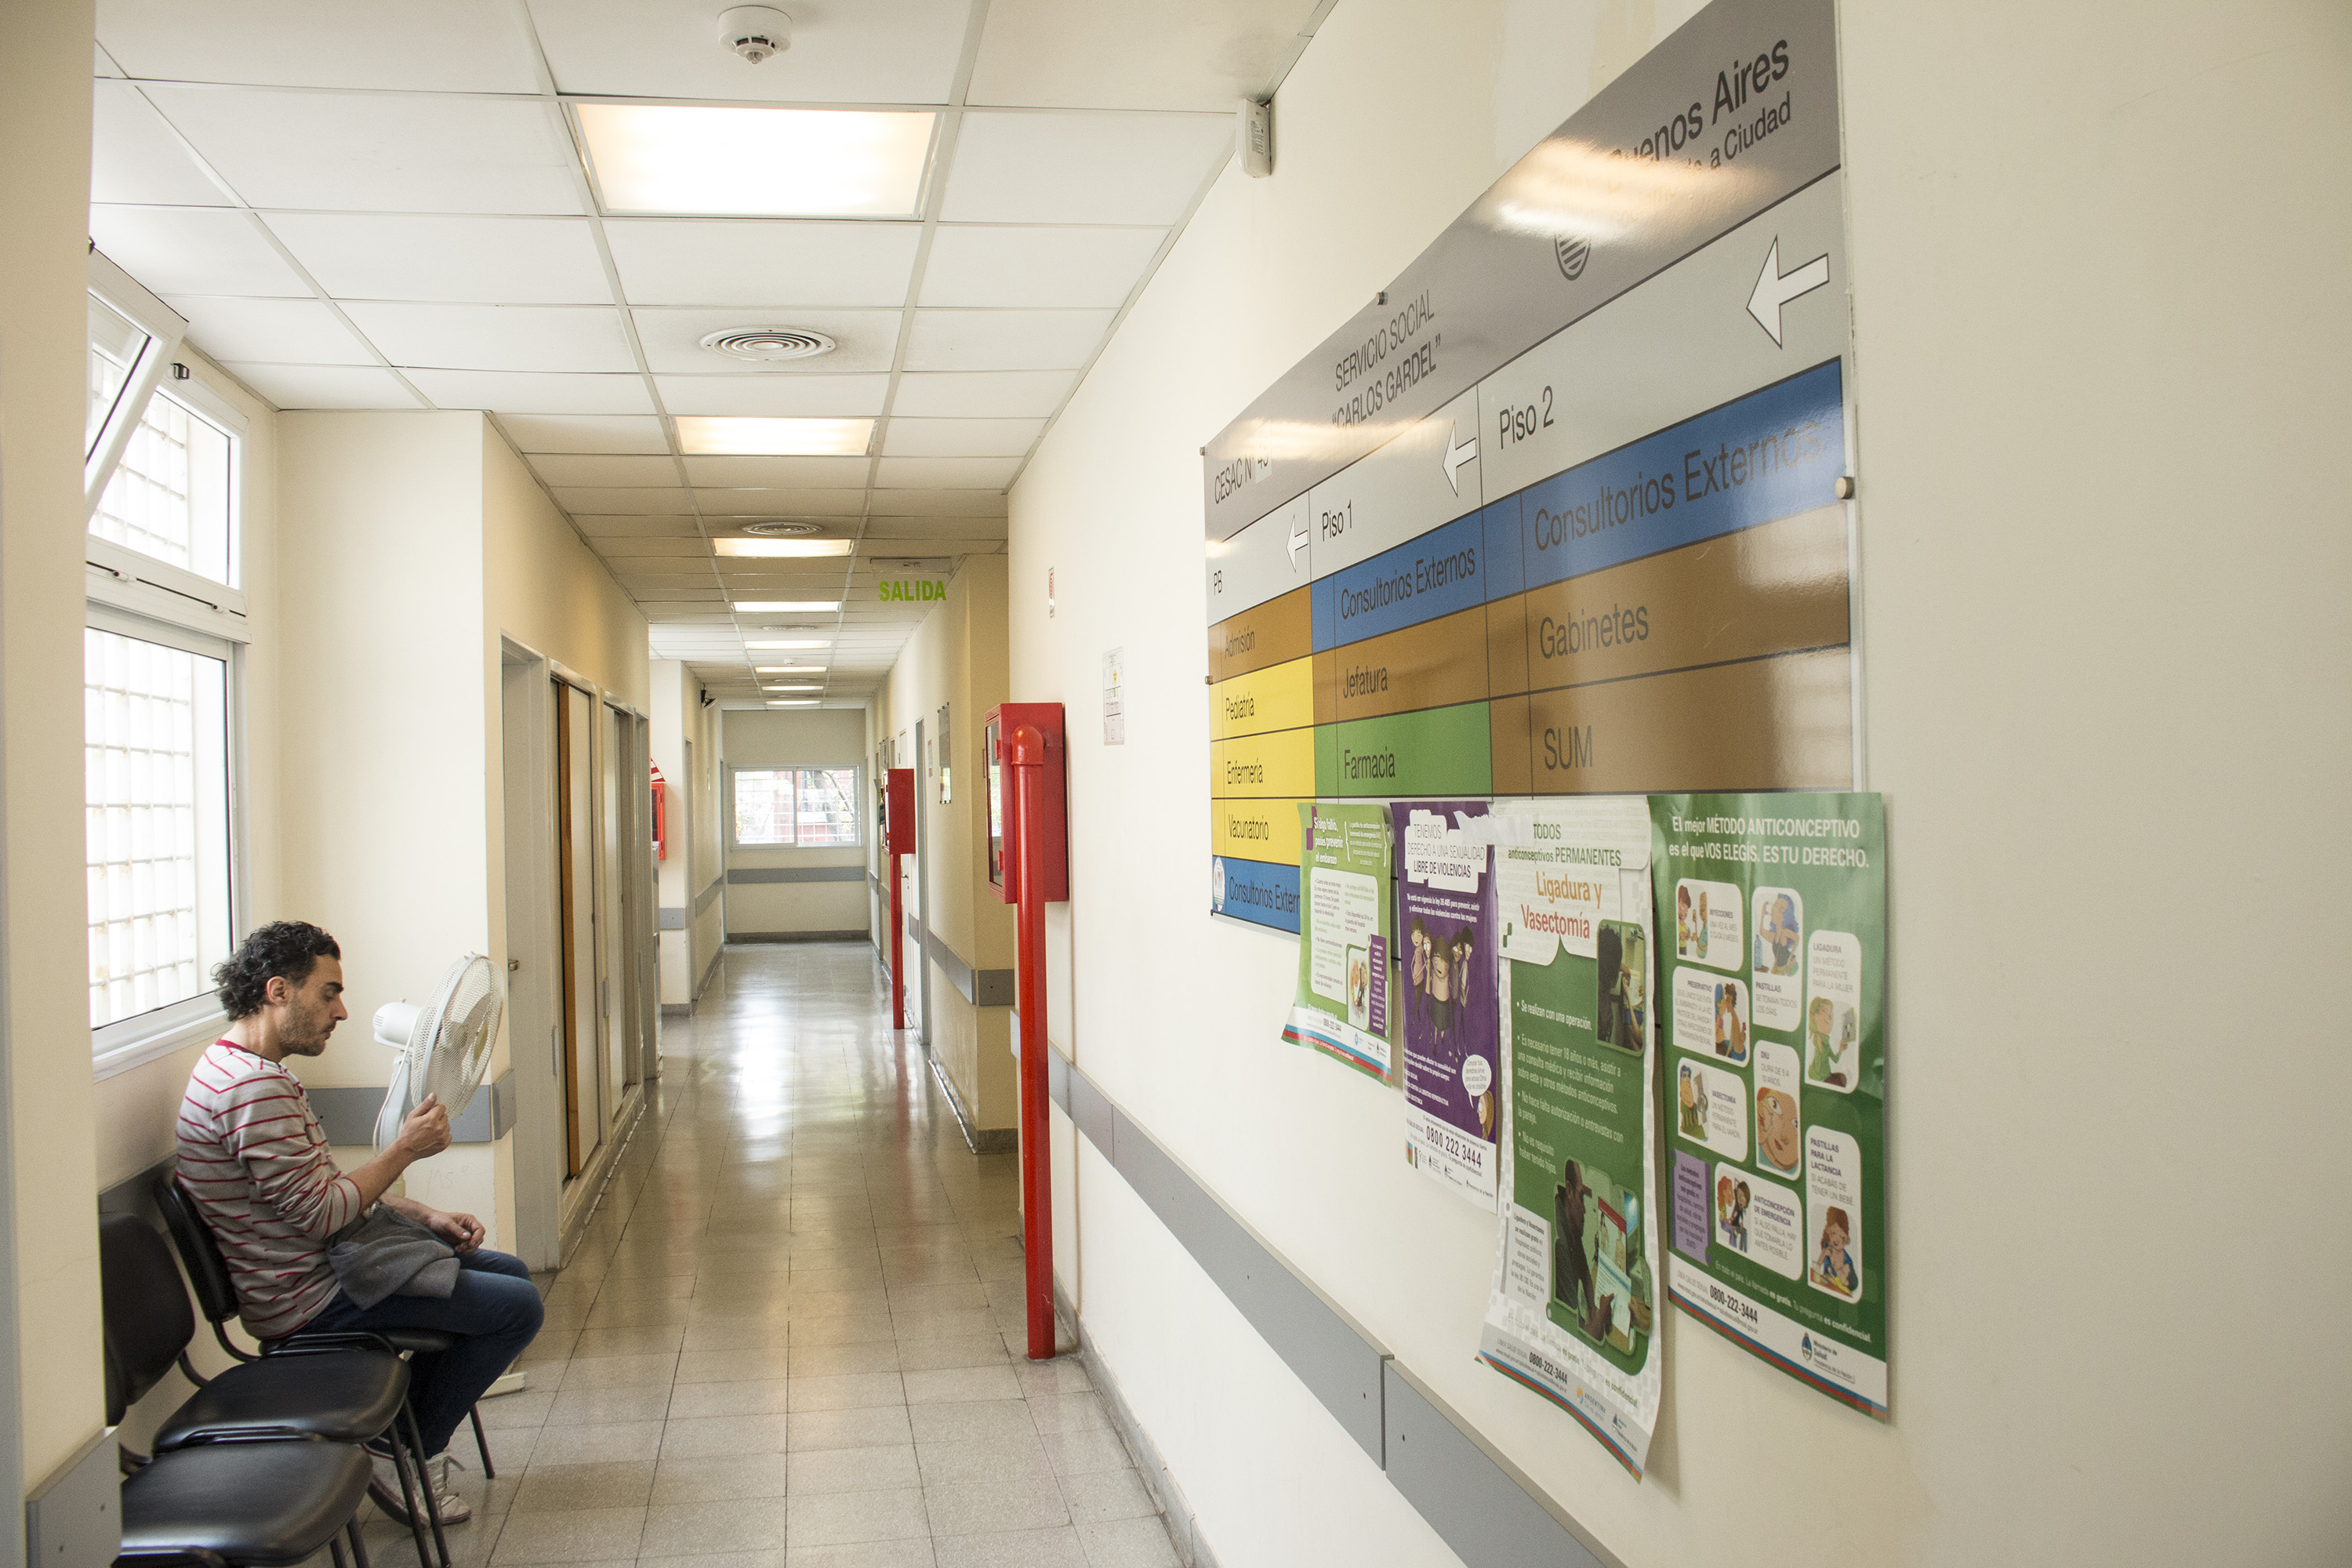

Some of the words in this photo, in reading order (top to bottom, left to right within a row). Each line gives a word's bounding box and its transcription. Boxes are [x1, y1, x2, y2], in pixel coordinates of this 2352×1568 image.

[1608, 102, 1704, 168] enos
[1712, 39, 1789, 125] Aires
[1725, 90, 1791, 161] Ciudad
[1335, 328, 1387, 392] SERVICIO
[1390, 289, 1435, 350] SOCIAL
[1500, 405, 1537, 450] Piso
[1542, 385, 1555, 429] 2
[1214, 457, 1243, 504] CESAC
[1535, 470, 1675, 550] Consultorios
[1683, 420, 1822, 503] Externos
[1322, 510, 1344, 542] Piso
[1347, 499, 1352, 529] 1
[879, 580, 947, 602] SALIDA
[1214, 570, 1223, 596] PB
[1341, 570, 1412, 620] Consultorios
[1416, 547, 1475, 595] Externos
[1225, 626, 1255, 659] Admisión
[1540, 604, 1650, 659] Gabinetes
[1343, 666, 1388, 699] Jefatura
[1225, 691, 1255, 721] Pediatría
[1345, 746, 1396, 779] Farmacia
[1544, 724, 1594, 771] SUM
[1227, 758, 1264, 785] Enfermería
[1228, 815, 1269, 841] Vacunatorio
[1414, 823, 1443, 840] TENEMOS
[1672, 816, 1682, 832] El
[1684, 817, 1706, 837] mejor
[1706, 813, 1746, 835] MÉTODO
[1747, 818, 1860, 839] ANTICONCEPTIVO
[1407, 842, 1432, 857] DERECHO
[1432, 844, 1437, 857] A
[1437, 844, 1449, 858] UNA
[1450, 844, 1486, 861] SEXUALIDAD
[1508, 847, 1554, 864] anticonceptivos
[1555, 847, 1622, 867] PERMANENTES
[1668, 844, 1679, 856] es
[1681, 841, 1690, 857] el
[1690, 845, 1704, 861] que
[1704, 842, 1722, 860] VOS
[1723, 841, 1759, 862] ELEGÍS.
[1762, 845, 1780, 863] ES
[1780, 846, 1798, 865] TU
[1802, 847, 1869, 868] DERECHO.
[1414, 860, 1428, 873] LIBRE
[1429, 861, 1437, 875] DE
[1437, 862, 1472, 878] VIOLENCIAS
[1229, 876, 1273, 908] Consultorios
[1275, 884, 1301, 914] Extern
[1536, 871, 1591, 904] Ligadura
[1594, 884, 1602, 910] y
[1521, 903, 1590, 939] Vasectomía
[1813, 942, 1842, 953] LIGADURA
[1755, 982, 1782, 993] PASTILLAS
[1521, 1000, 1527, 1012] Se
[1527, 1004, 1545, 1018] realizan
[1545, 1009, 1555, 1021] con
[1426, 1125, 1443, 1148] 0800
[1446, 1135, 1459, 1156] 222
[1461, 1144, 1482, 1169] 3444
[1810, 1138, 1839, 1152] PASTILLAS
[1810, 1149, 1825, 1160] PARA
[1825, 1153, 1834, 1163] LA
[1811, 1160, 1842, 1177] LACTANCIA
[1761, 1207, 1791, 1227] EMERGENCIA
[1709, 1284, 1759, 1324] 0800-222-3444
[1529, 1352, 1568, 1385] 0800-222-3444
